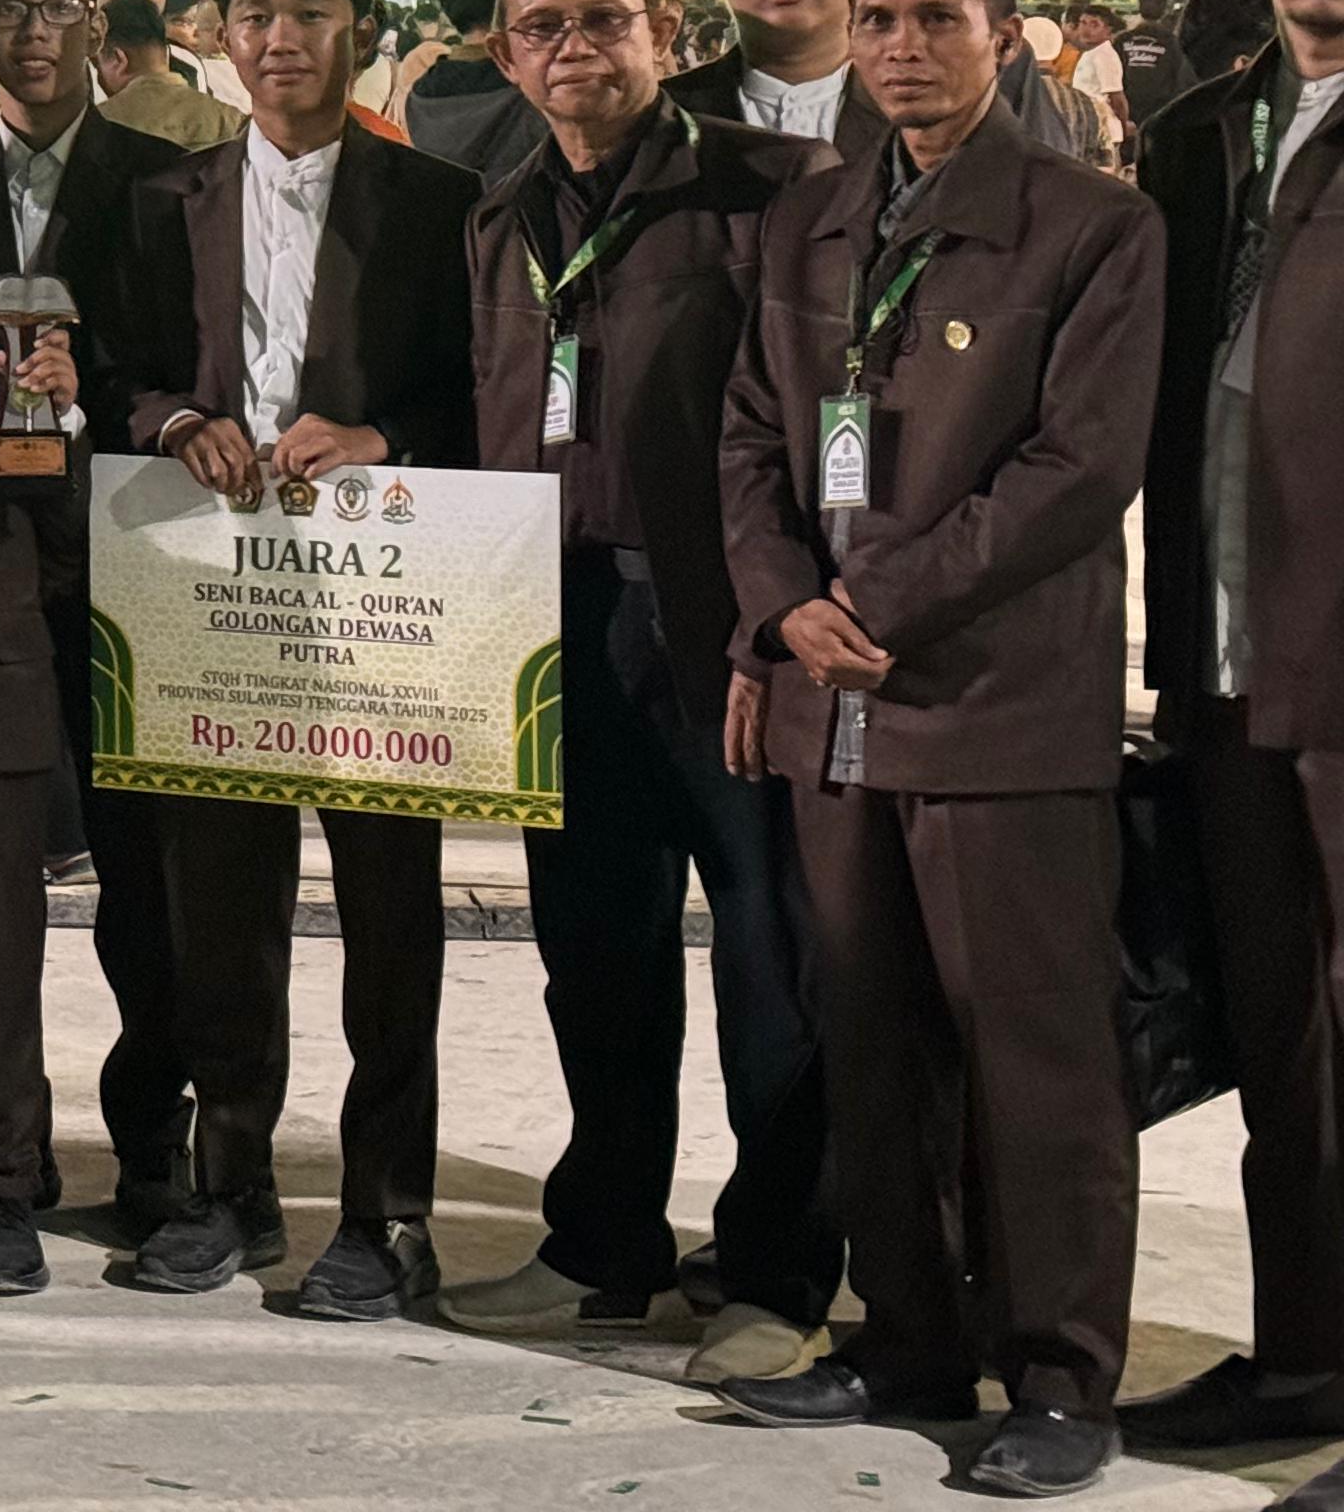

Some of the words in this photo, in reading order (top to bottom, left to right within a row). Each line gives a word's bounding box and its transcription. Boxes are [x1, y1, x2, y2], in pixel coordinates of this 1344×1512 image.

[231, 535, 366, 578] JUARA
[379, 544, 402, 579] 2
[193, 582, 242, 604] SENI
[248, 586, 307, 608] BACA
[310, 590, 341, 610] AL
[360, 593, 443, 617] QUR'AN
[210, 609, 330, 635] GOLONGAN
[338, 619, 434, 643] DEWASA
[278, 641, 355, 665] PUTRA
[200, 669, 240, 688] STQH
[243, 672, 309, 691] TINGKAT
[310, 677, 390, 698] NASIONAL
[391, 684, 439, 701] XXVIII
[157, 683, 225, 702] PROVINSI
[227, 689, 302, 709] SULAWESI
[305, 694, 389, 716] TENGGARA
[391, 701, 445, 720] TAHUN
[447, 706, 488, 723] 2025
[191, 714, 244, 757] Rp.
[253, 719, 452, 766] 20.000.000
